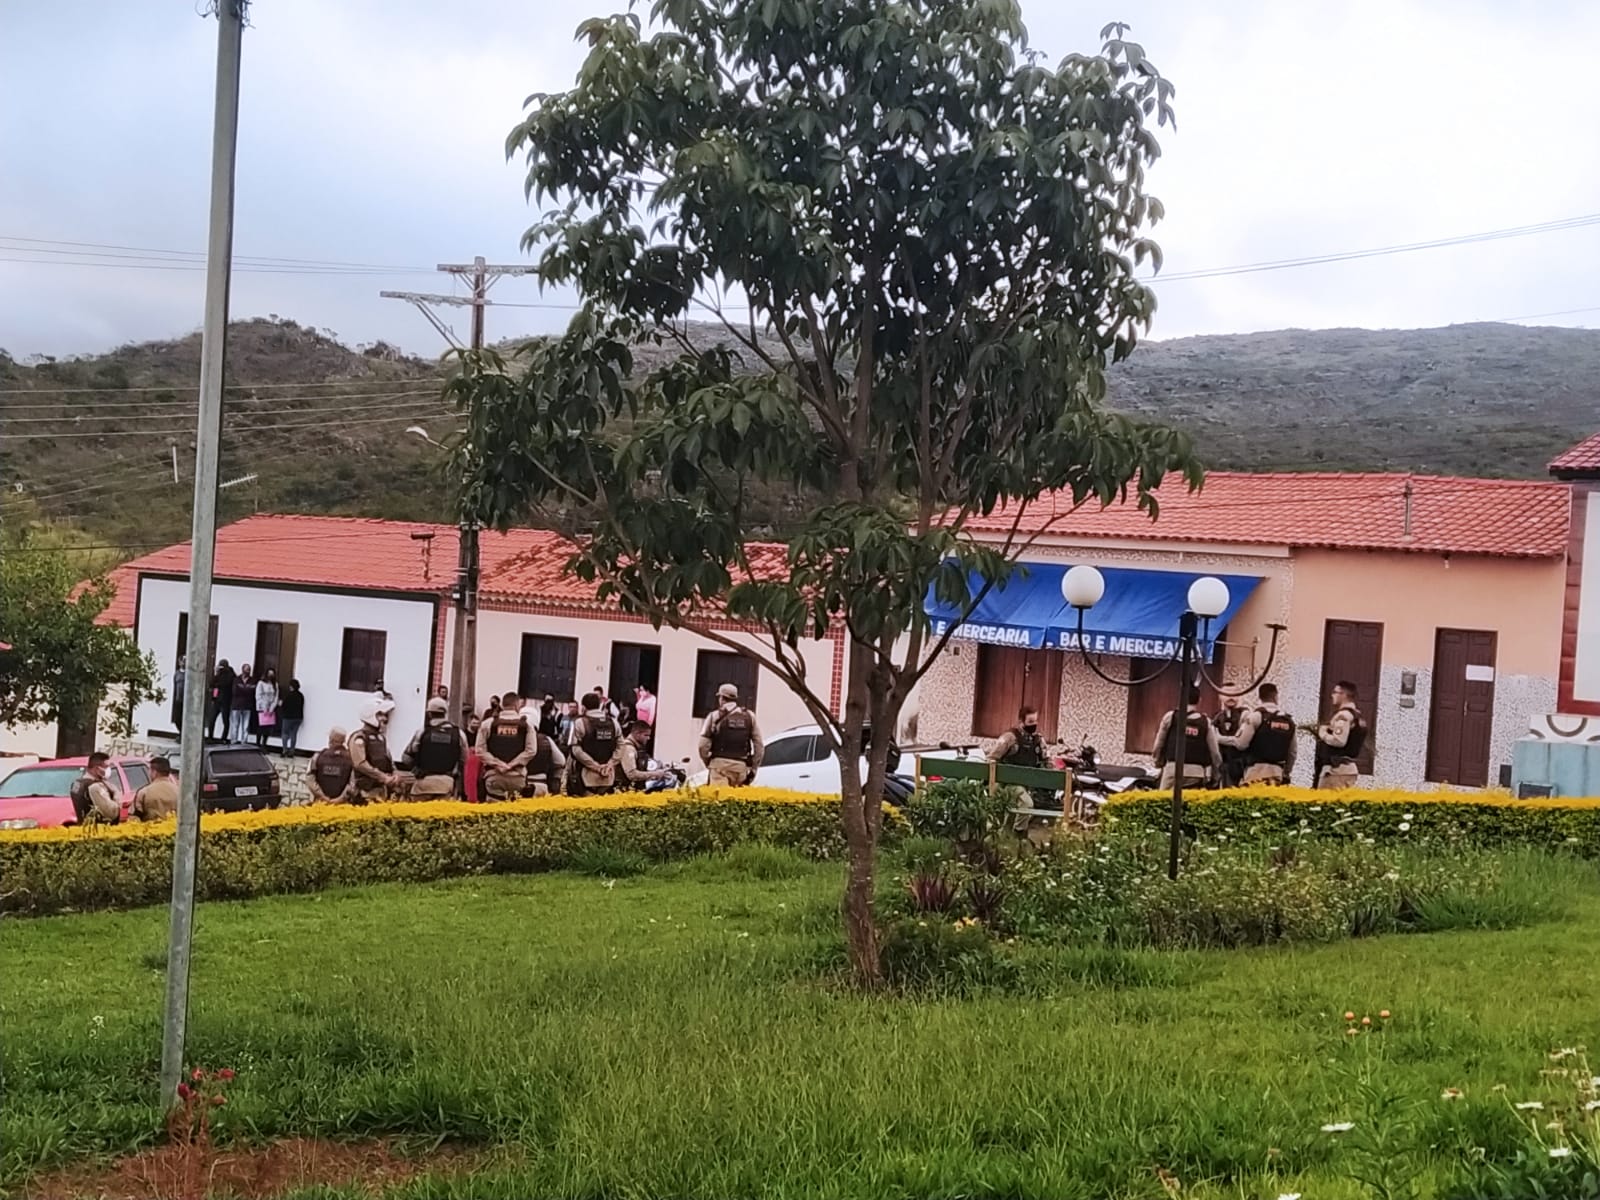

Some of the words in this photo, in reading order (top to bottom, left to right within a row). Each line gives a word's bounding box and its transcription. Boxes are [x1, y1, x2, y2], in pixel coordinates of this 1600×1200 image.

[936, 620, 947, 635] E
[1060, 632, 1091, 650] BAR
[1095, 634, 1106, 650] E
[1109, 636, 1201, 658] MERCEA
[497, 726, 518, 735] PETO
